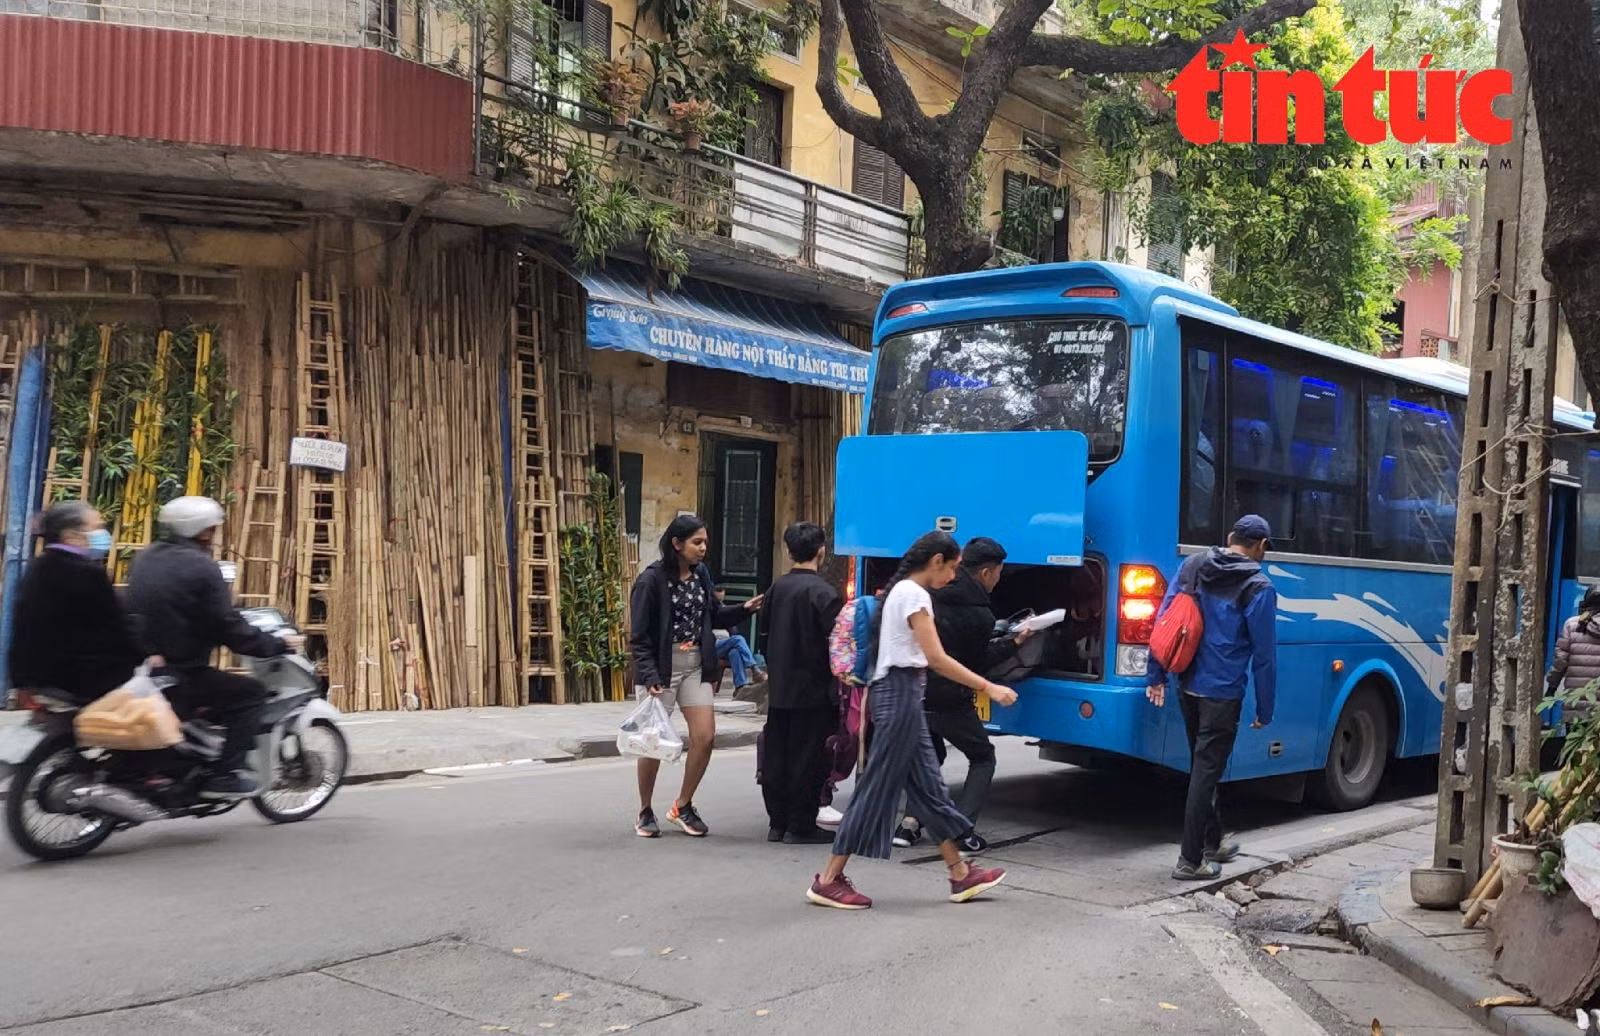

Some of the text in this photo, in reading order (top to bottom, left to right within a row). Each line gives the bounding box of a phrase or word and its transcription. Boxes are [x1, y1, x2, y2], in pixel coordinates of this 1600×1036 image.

[649, 325, 703, 352] CHUYÊN
[704, 334, 740, 359] HÀNG
[742, 341, 765, 367] NỘI
[766, 345, 797, 370] THẤT
[797, 348, 828, 375] BẰNG
[829, 361, 849, 380] TRE
